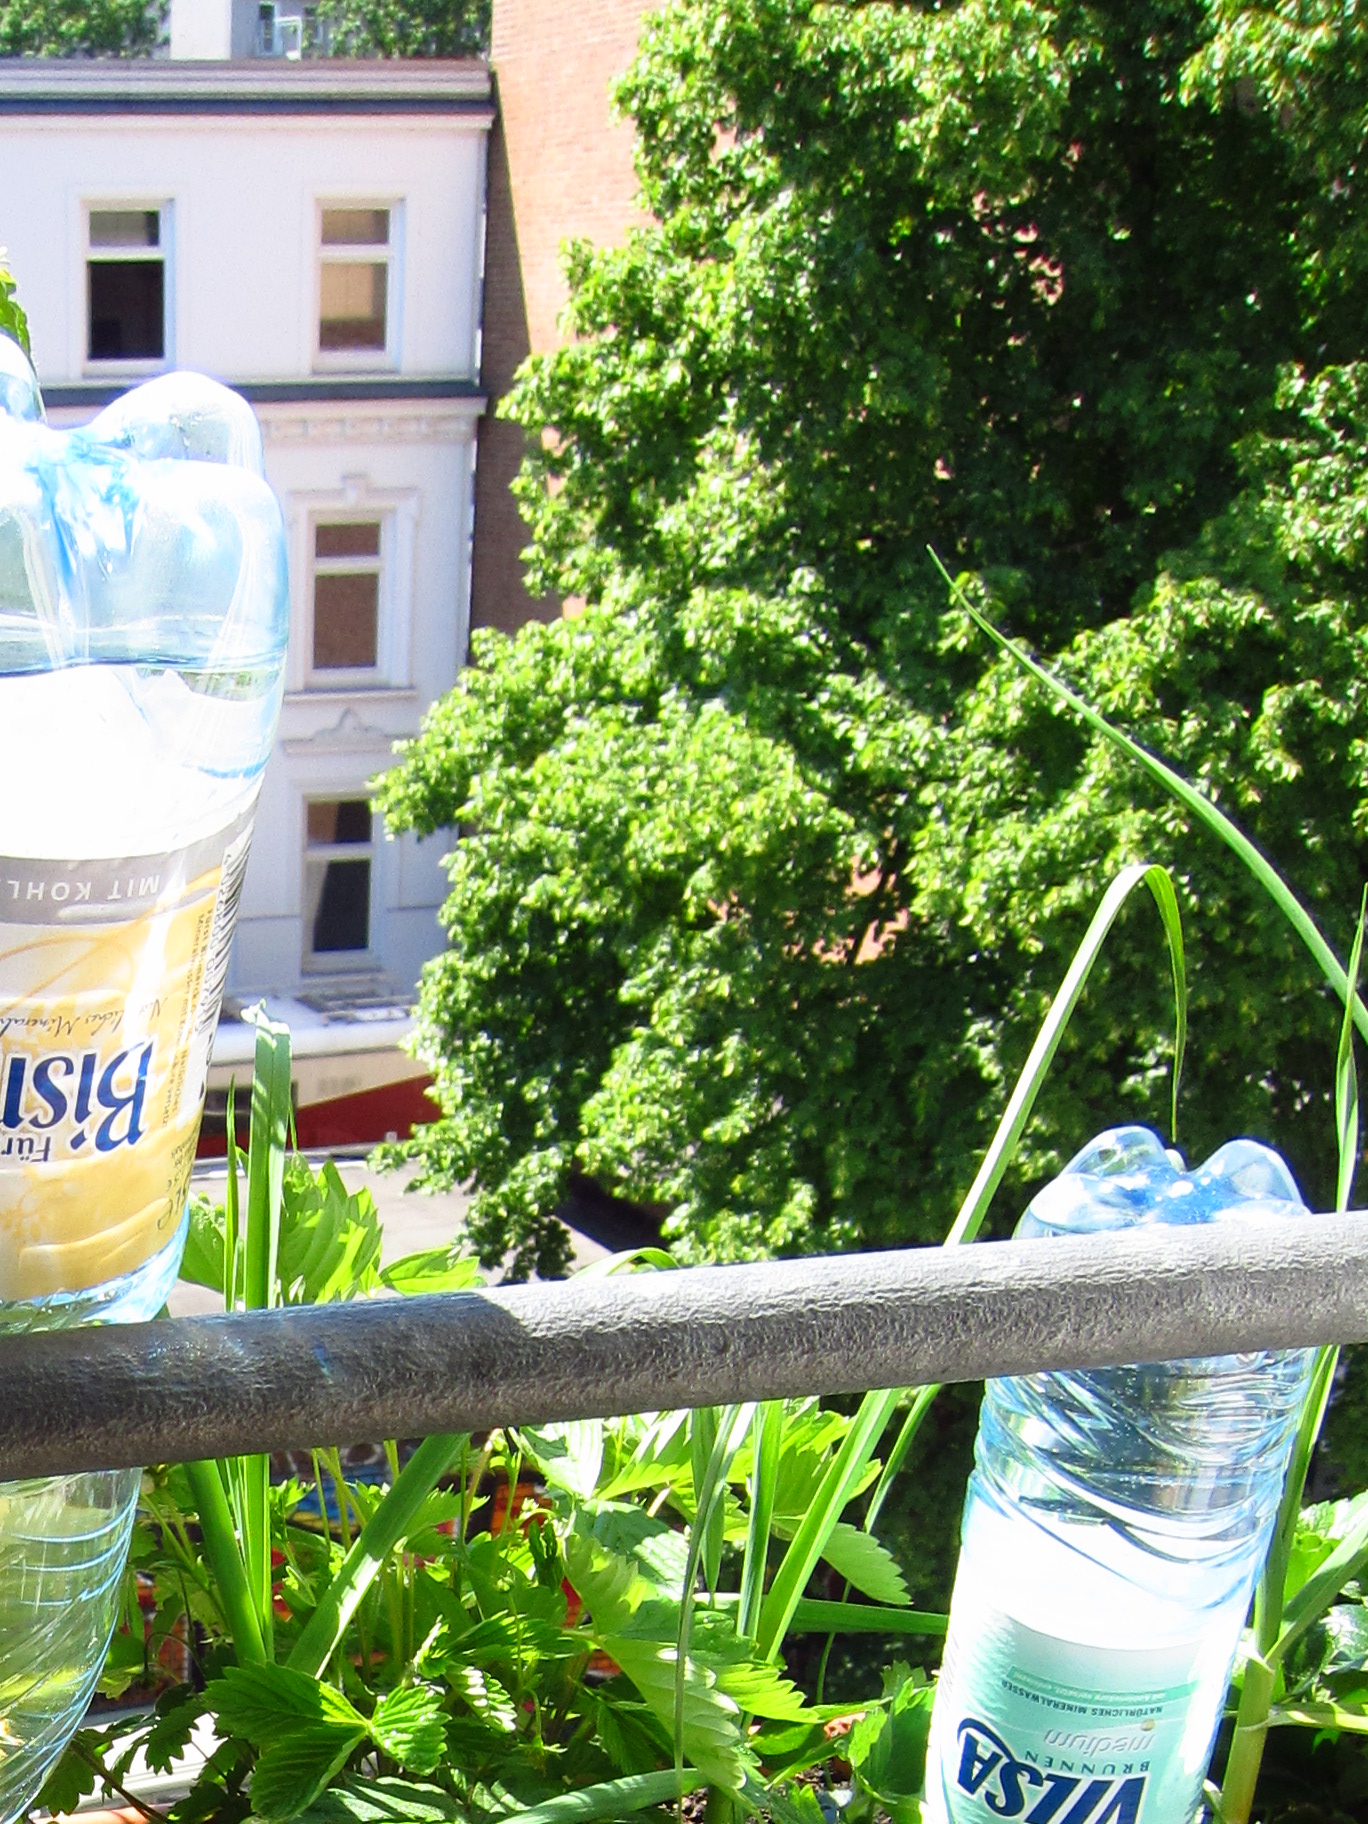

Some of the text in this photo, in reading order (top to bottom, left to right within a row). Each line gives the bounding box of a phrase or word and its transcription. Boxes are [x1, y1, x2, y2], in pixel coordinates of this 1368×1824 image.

[107, 873, 160, 902] MIT
[1000, 1679, 1164, 1718] NATÜRLICHES MINERALWASSER
[1043, 1728, 1156, 1758] medium
[1024, 1750, 1151, 1776] BRUNNEN
